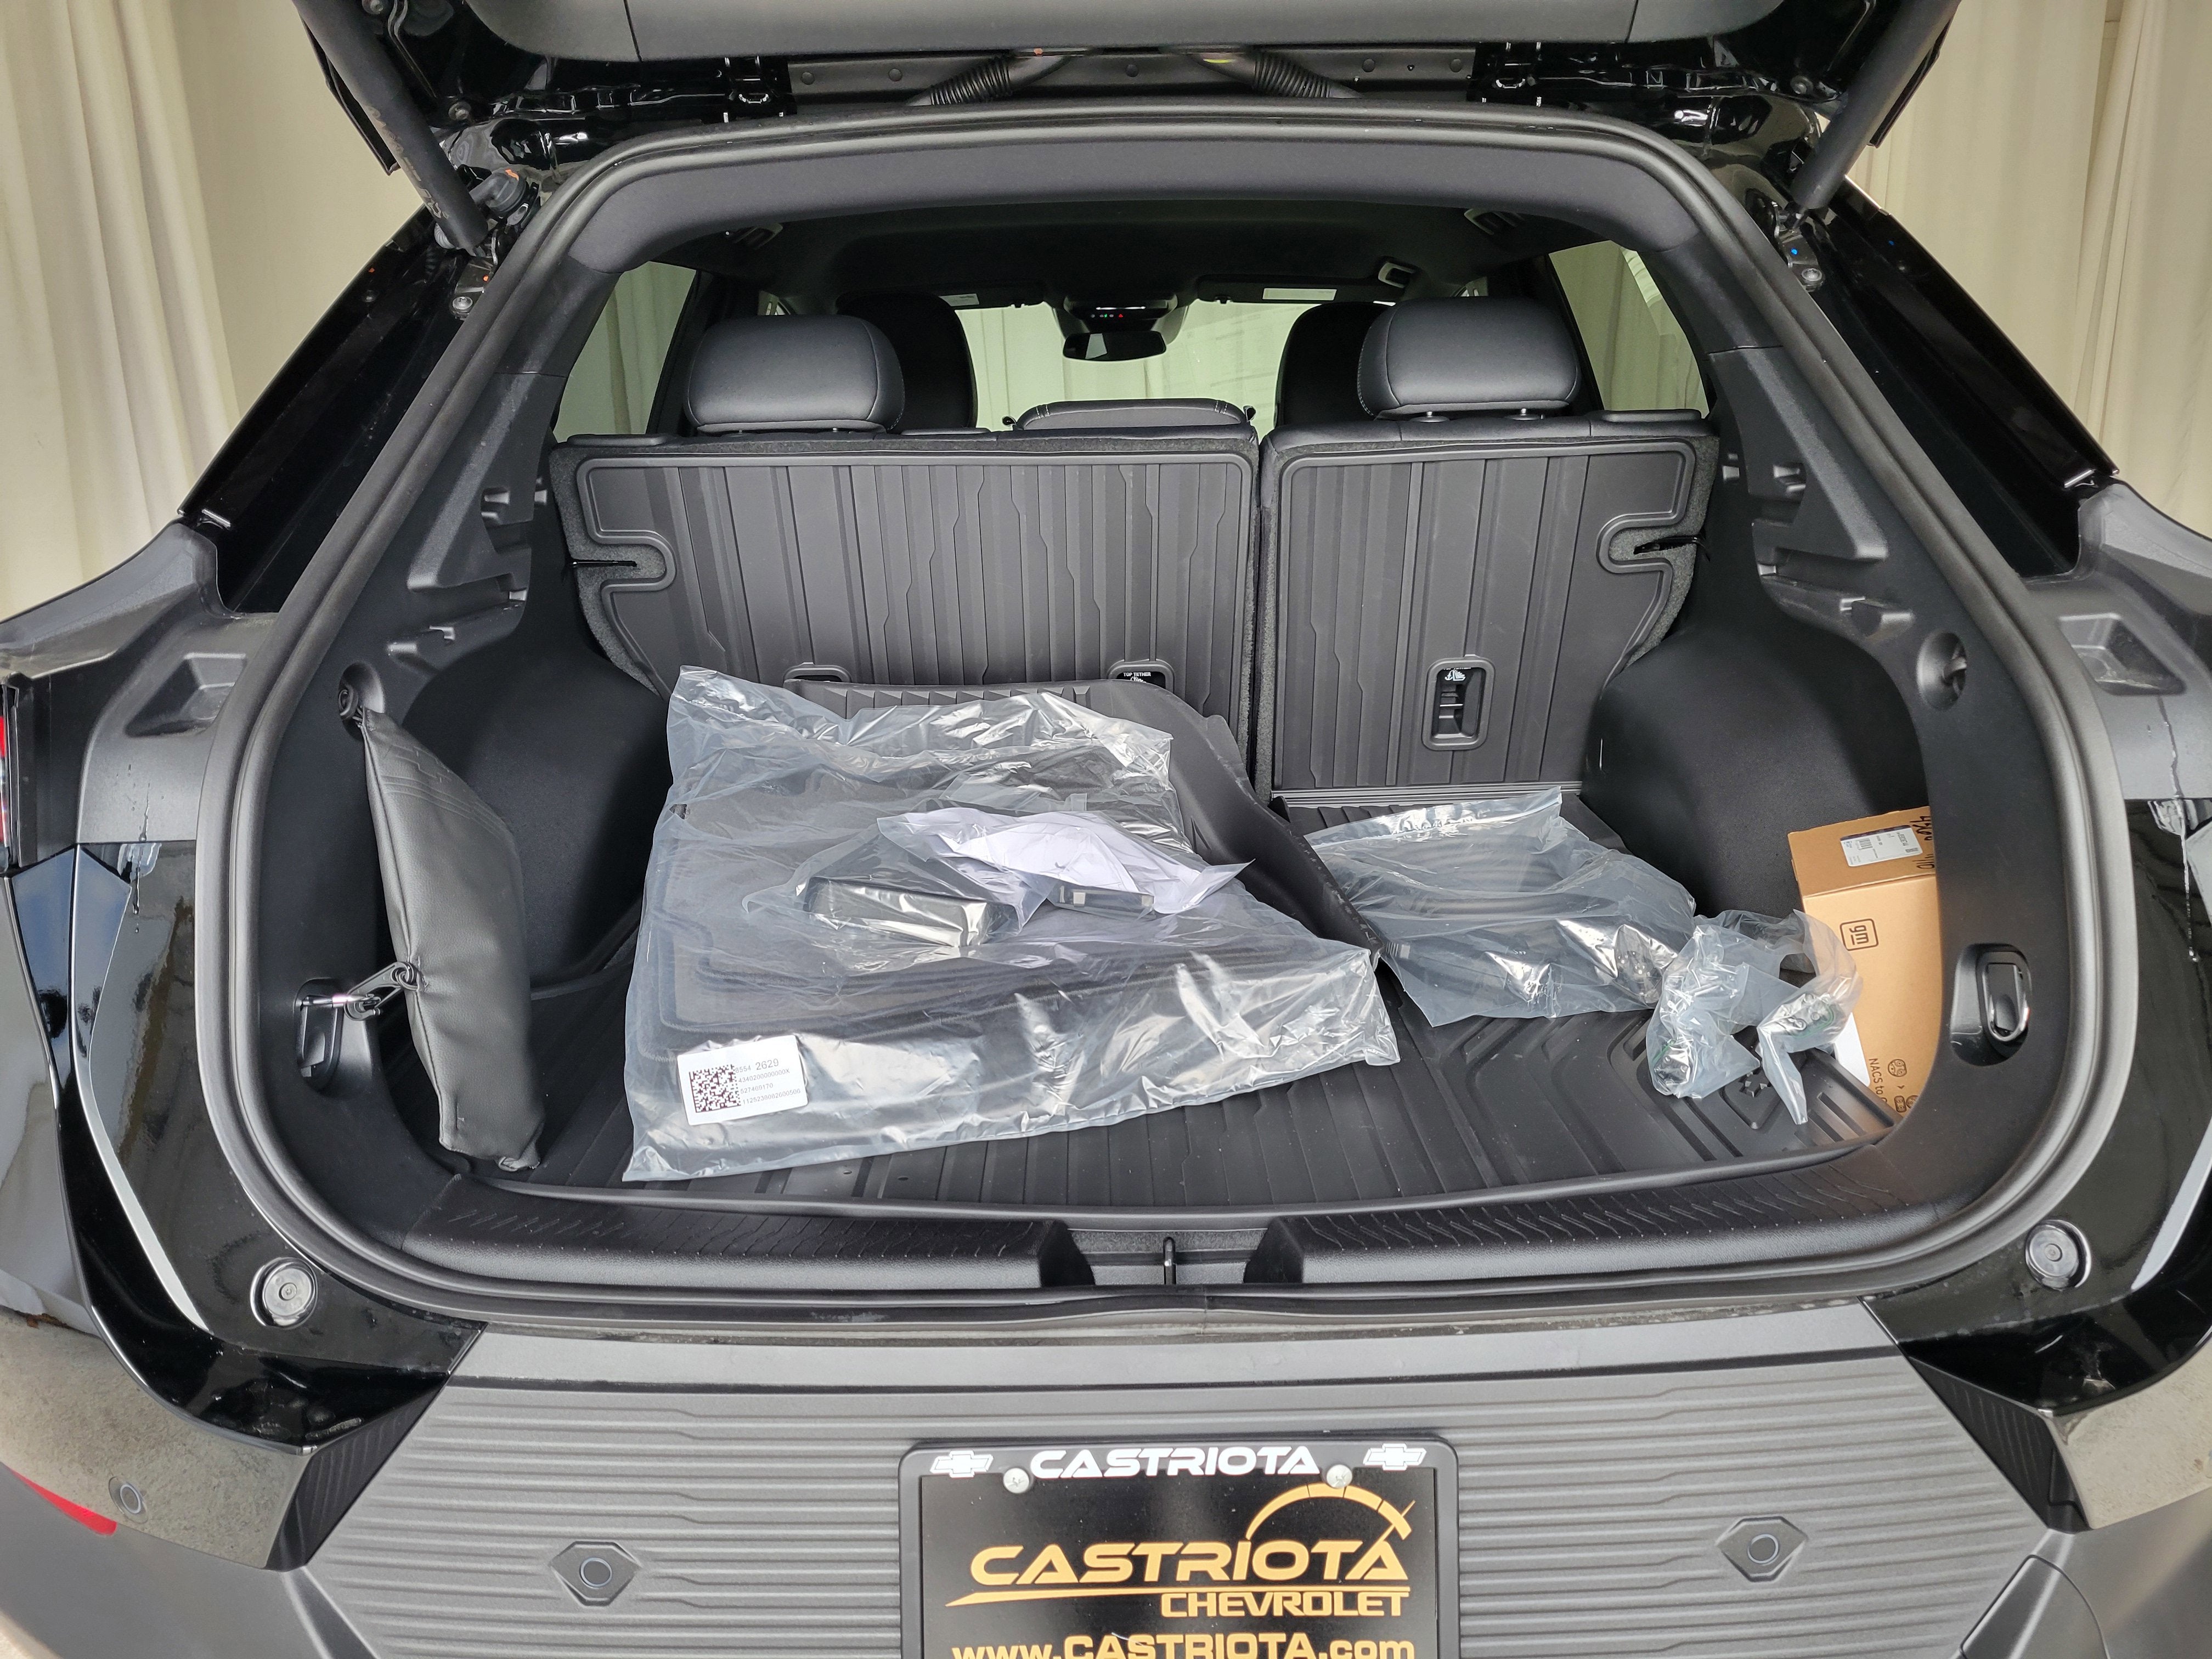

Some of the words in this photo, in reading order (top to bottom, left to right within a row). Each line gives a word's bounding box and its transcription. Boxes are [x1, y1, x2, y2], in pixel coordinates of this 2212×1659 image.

[1849, 925, 1869, 945] gm
[755, 1058, 779, 1070] 2629
[1869, 1058, 1883, 1084] NACS
[1875, 1085, 1885, 1095] to
[1030, 1446, 1320, 1479] CASTRIOTA
[970, 1539, 1409, 1585] CASTRIOTA
[1161, 1592, 1409, 1618] CHEVROLET
